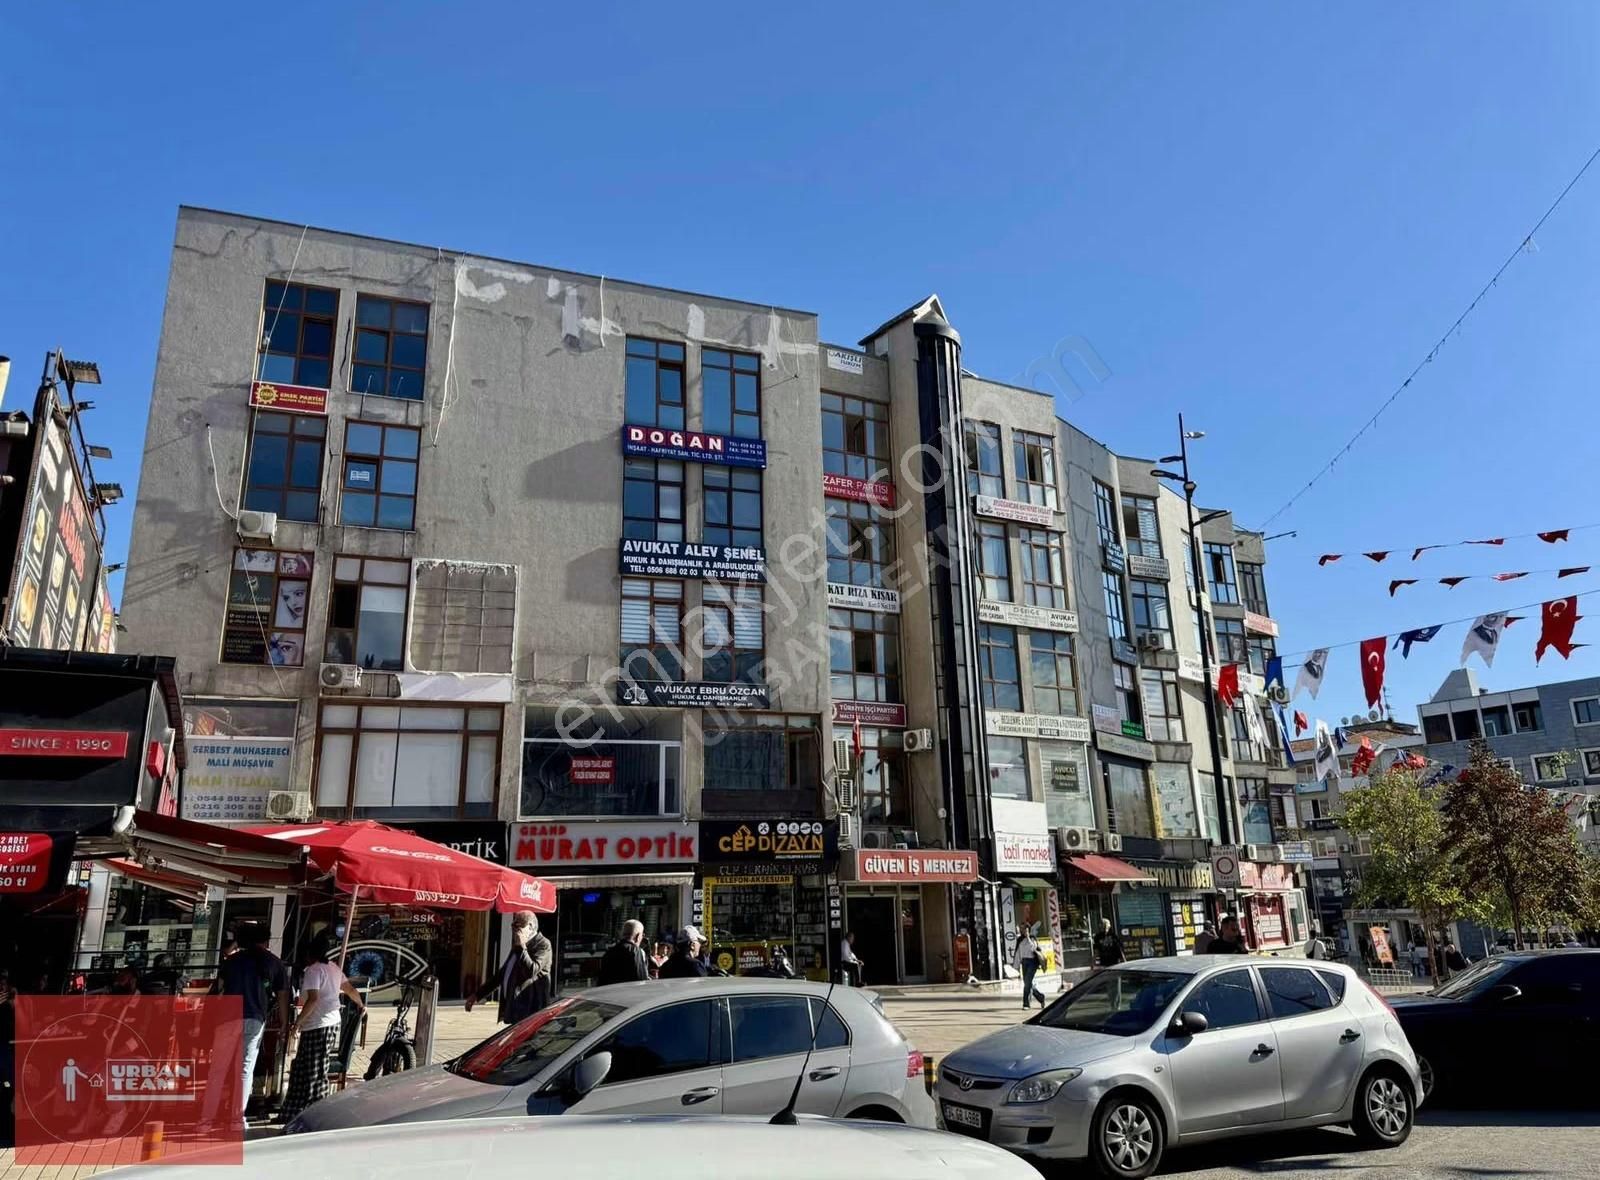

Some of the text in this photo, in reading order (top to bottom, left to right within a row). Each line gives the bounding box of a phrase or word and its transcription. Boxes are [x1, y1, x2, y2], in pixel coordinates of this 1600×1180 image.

[630, 428, 722, 450] DOĞAN
[824, 476, 853, 488] ZAFER
[623, 540, 764, 562] AVUKAT ALEV ŞENEL
[623, 556, 648, 564] HUKUK
[658, 558, 703, 568] DANIŞMANLIK
[713, 562, 764, 572] ARABULUCULUK
[828, 585, 845, 595] KAT
[848, 587, 867, 598] RIZA
[654, 685, 765, 696] AVUKAT EBRU ÖZCAN
[839, 704, 864, 712] TÜRKİYE
[11, 738, 61, 749] SINCE
[76, 739, 112, 750] 1990
[193, 745, 231, 755] SERBEST
[207, 757, 274, 768] MALİ MÜŞAVİR
[520, 825, 567, 836] GRAND
[8, 837, 28, 845] ADET
[516, 831, 694, 861] MURAT OPTİK
[719, 832, 823, 852] CEP DİZAYN
[438, 837, 499, 858] PTİK
[1004, 843, 1051, 861] tatil market
[865, 855, 972, 875] GÜVEN İŞ MERKEZİ
[413, 914, 435, 922] SSK
